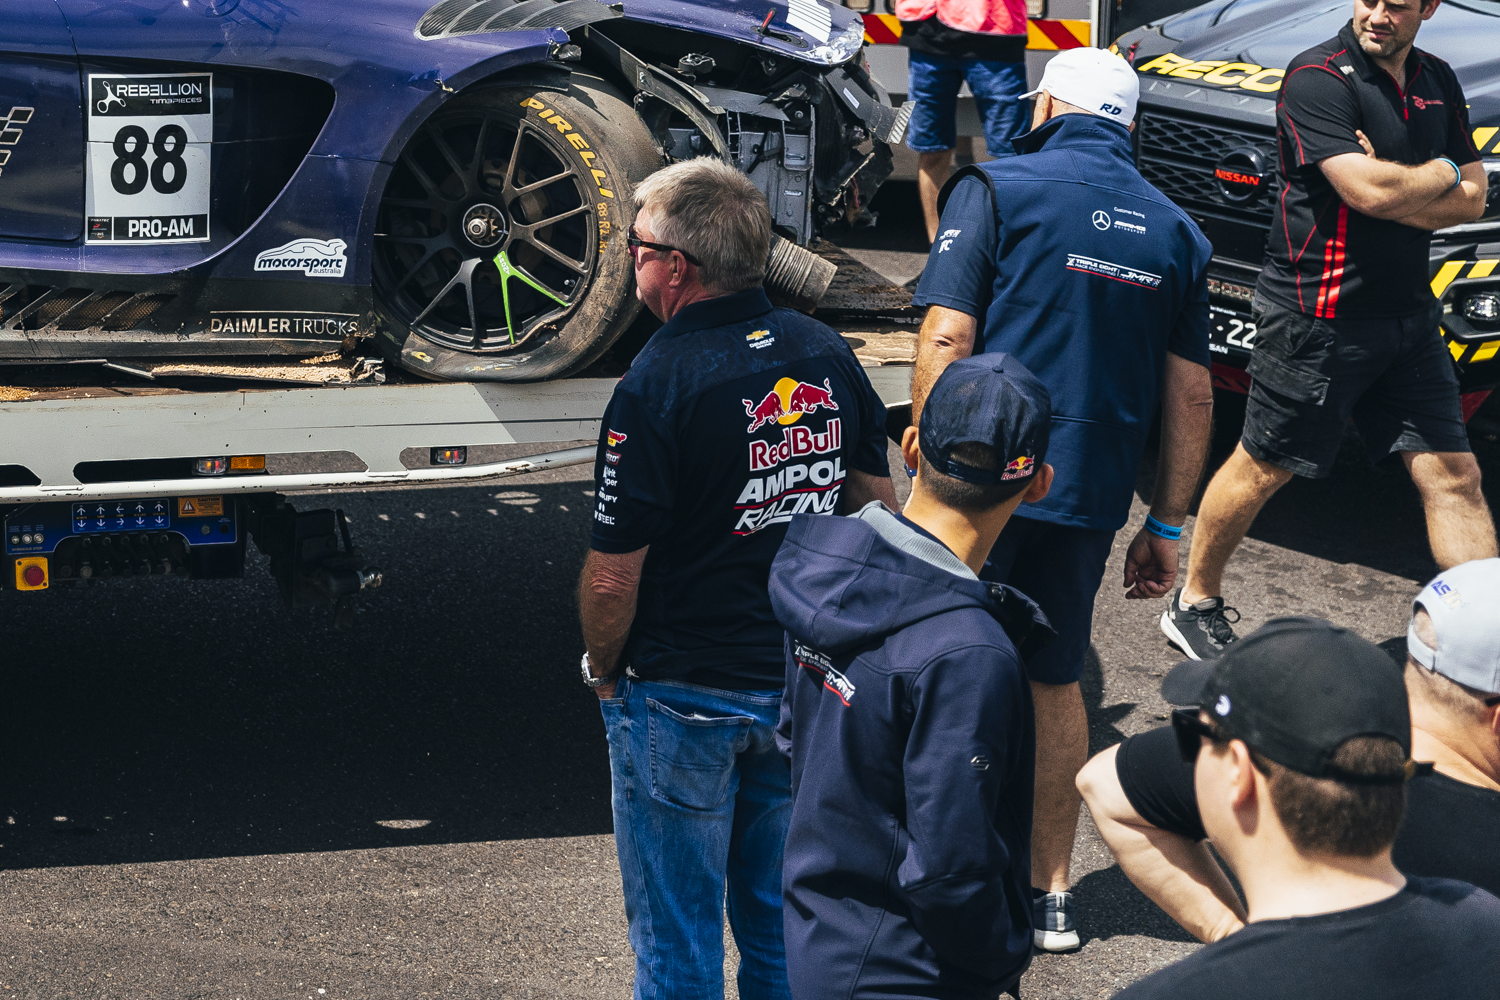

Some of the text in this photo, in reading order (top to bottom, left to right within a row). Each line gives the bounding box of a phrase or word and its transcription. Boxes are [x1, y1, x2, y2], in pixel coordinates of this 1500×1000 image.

[1100, 103, 1122, 115] RD
[520, 97, 614, 198] PIRELLI
[111, 124, 188, 195] 88
[1215, 168, 1260, 186] NISSAN
[128, 218, 194, 237] PRO-AM
[258, 258, 343, 272] motorsport
[1075, 259, 1118, 272] TRIPLE EIGHT
[211, 318, 358, 336] DAIMLER TRUCKS
[750, 418, 841, 471] Red Bull
[736, 457, 846, 503] AMPOL
[734, 484, 841, 530] RACING
